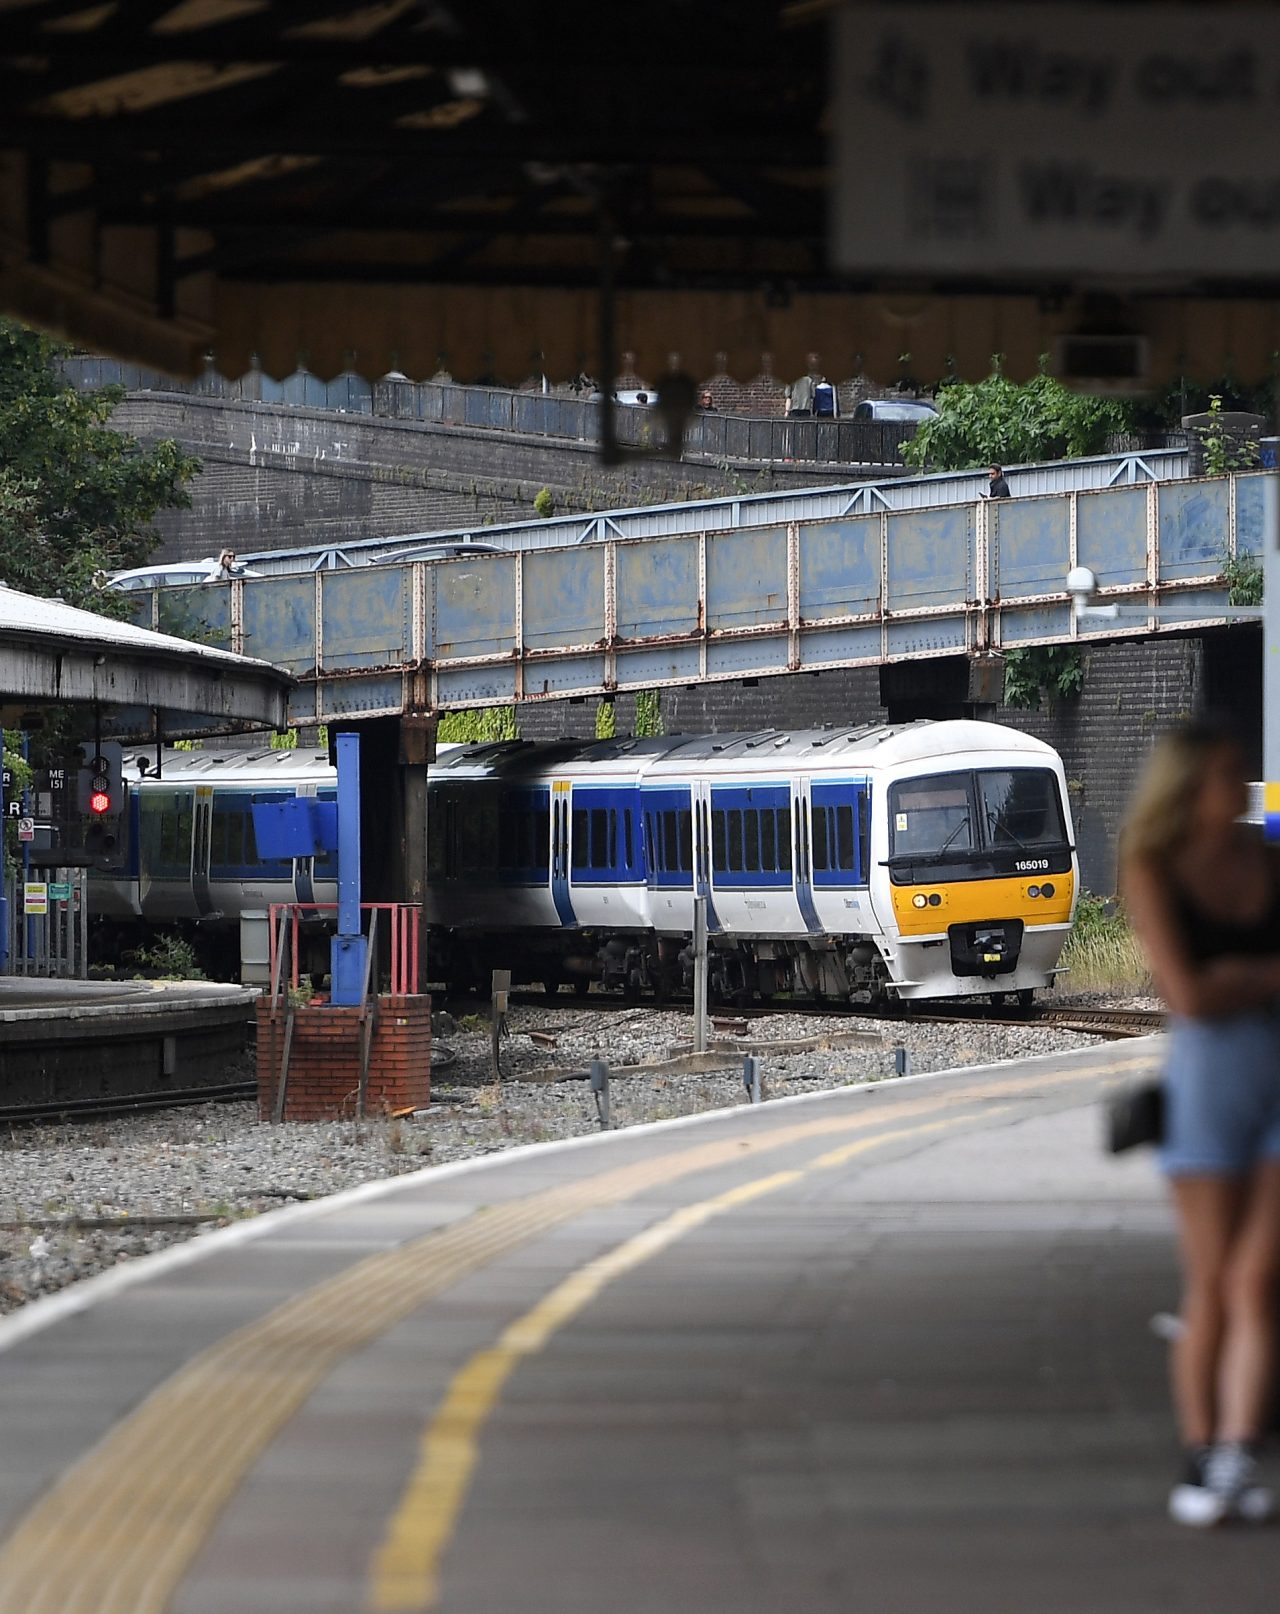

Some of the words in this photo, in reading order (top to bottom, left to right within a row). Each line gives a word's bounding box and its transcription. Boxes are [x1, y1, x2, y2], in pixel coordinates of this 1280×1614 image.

[967, 38, 1117, 118] Way
[1138, 42, 1257, 106] out
[1020, 160, 1168, 240] Way
[3, 772, 11, 783] R
[49, 770, 65, 779] ME
[50, 780, 63, 789] 151
[10, 802, 20, 815] R
[1015, 859, 1049, 871] 165019
